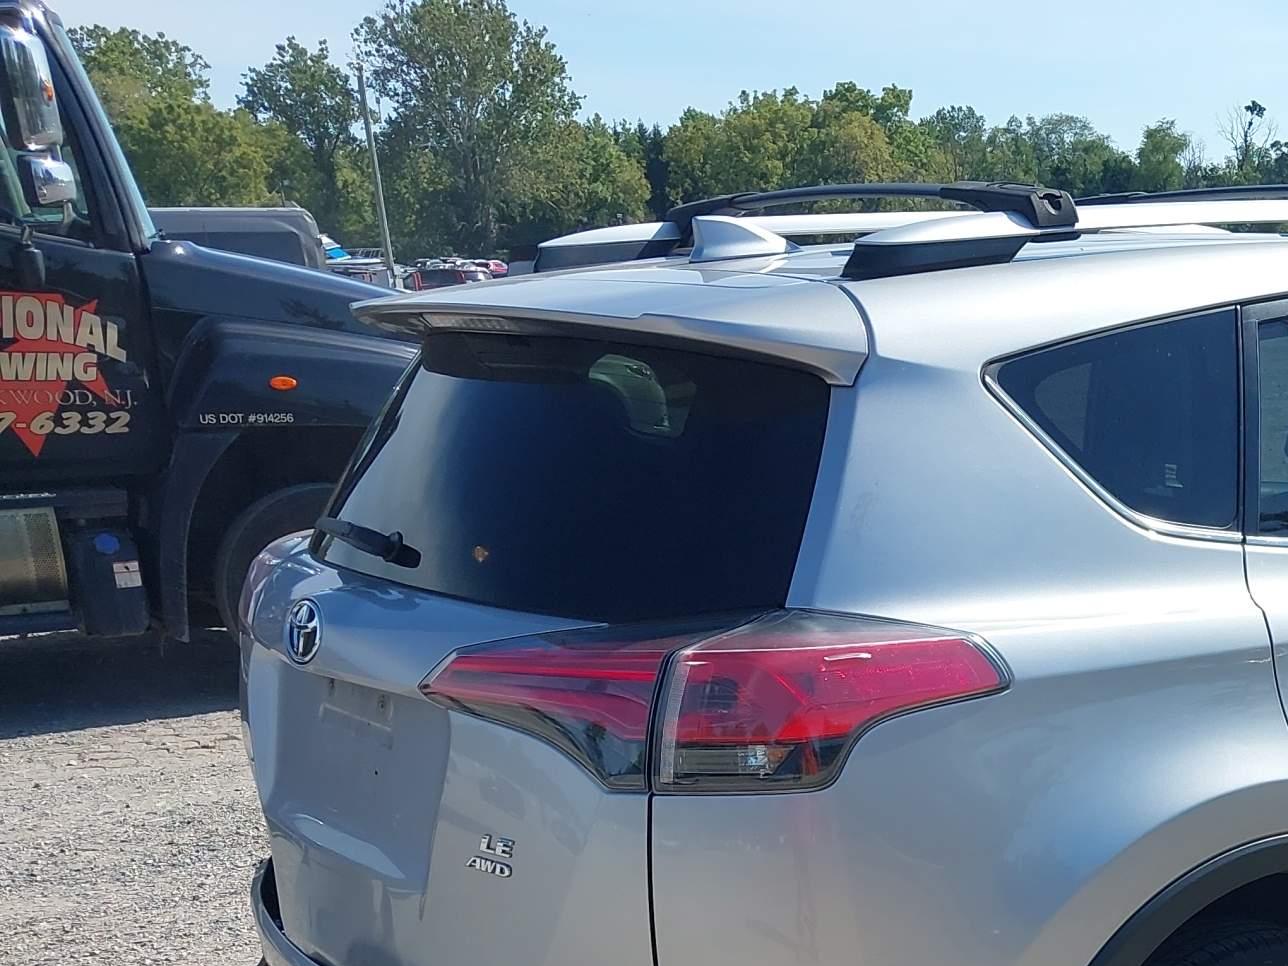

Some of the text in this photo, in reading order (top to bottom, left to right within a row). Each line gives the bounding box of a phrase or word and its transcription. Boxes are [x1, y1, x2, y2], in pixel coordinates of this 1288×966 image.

[0, 352, 97, 381] WING
[103, 389, 138, 409] N.J.
[0, 411, 130, 434] 7-6332
[199, 412, 294, 424] US DOT #914256
[479, 834, 515, 858] LE
[466, 855, 513, 878] AWD
